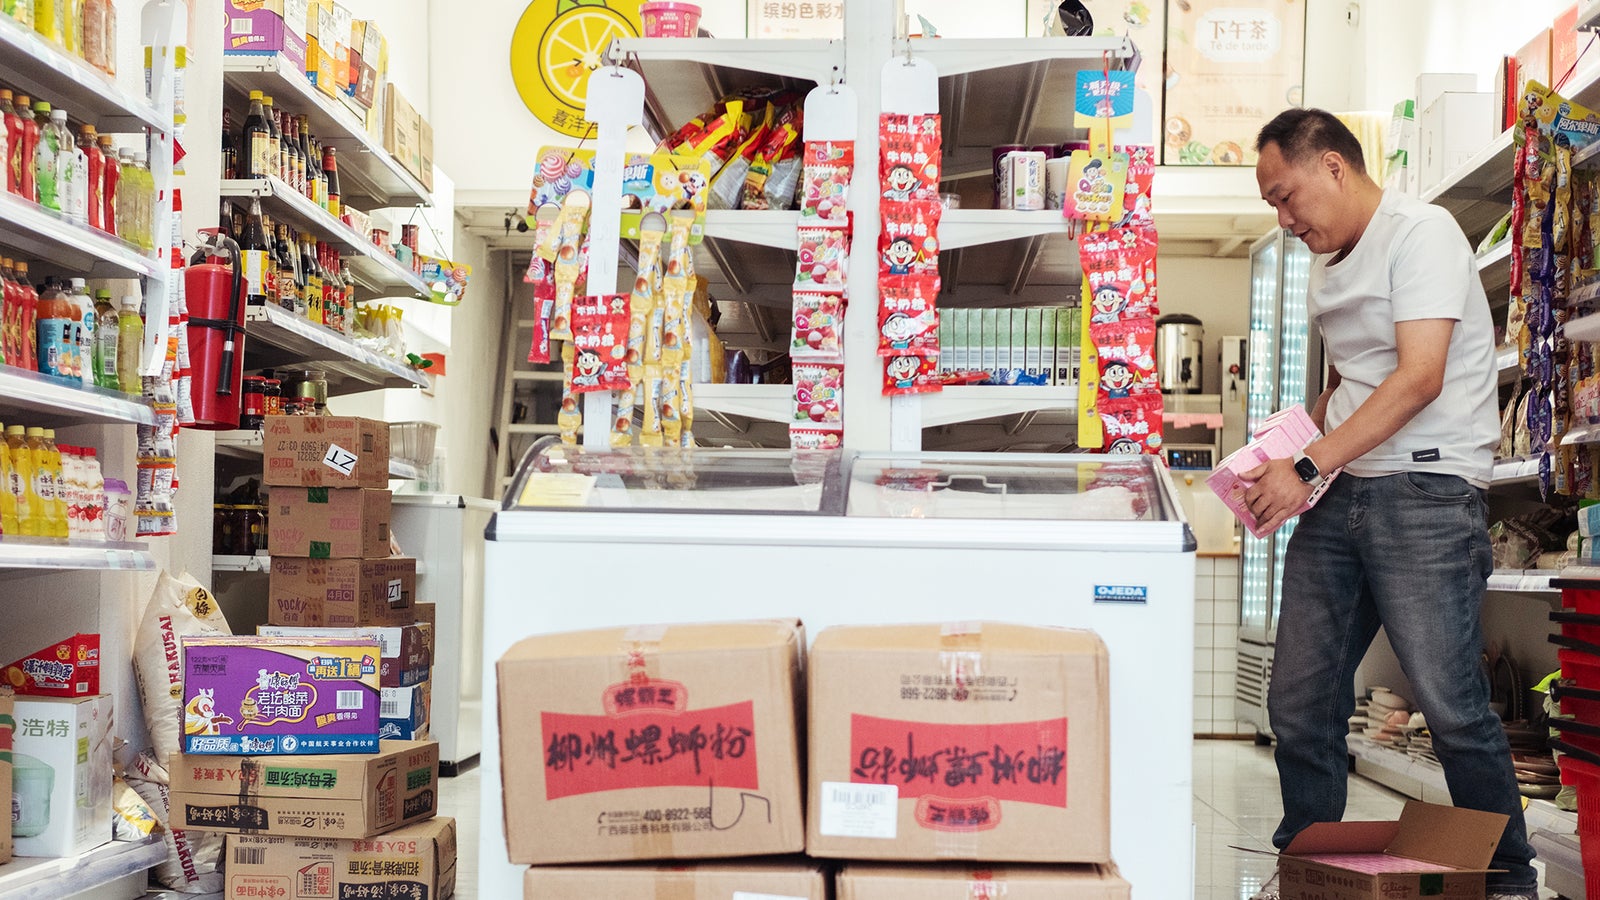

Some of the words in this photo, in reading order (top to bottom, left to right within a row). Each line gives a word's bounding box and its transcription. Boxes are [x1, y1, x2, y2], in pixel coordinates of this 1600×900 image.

[1207, 20, 1268, 40] 下午茶
[887, 150, 928, 164] 牛奶糖
[886, 222, 928, 237] 牛奶糖
[884, 298, 926, 311] 牛奶糖
[575, 334, 615, 347] 牛奶糖
[1107, 421, 1149, 436] 牛奶糖
[326, 450, 356, 471] ZT
[388, 584, 401, 599] ZT
[1097, 587, 1144, 596] OJEDA
[257, 690, 308, 705] 老坛酸菜
[262, 705, 302, 718] 牛肉面
[22, 718, 70, 737] 浩特
[300, 740, 375, 748] 中国航天事业合作伙伴
[267, 770, 338, 788] 老母鸡汤面
[188, 806, 227, 821] 汤好喝
[348, 857, 420, 877] 招牌猪骨汤面
[236, 884, 286, 899] 白家中国面
[343, 882, 385, 900] 汤好喝
